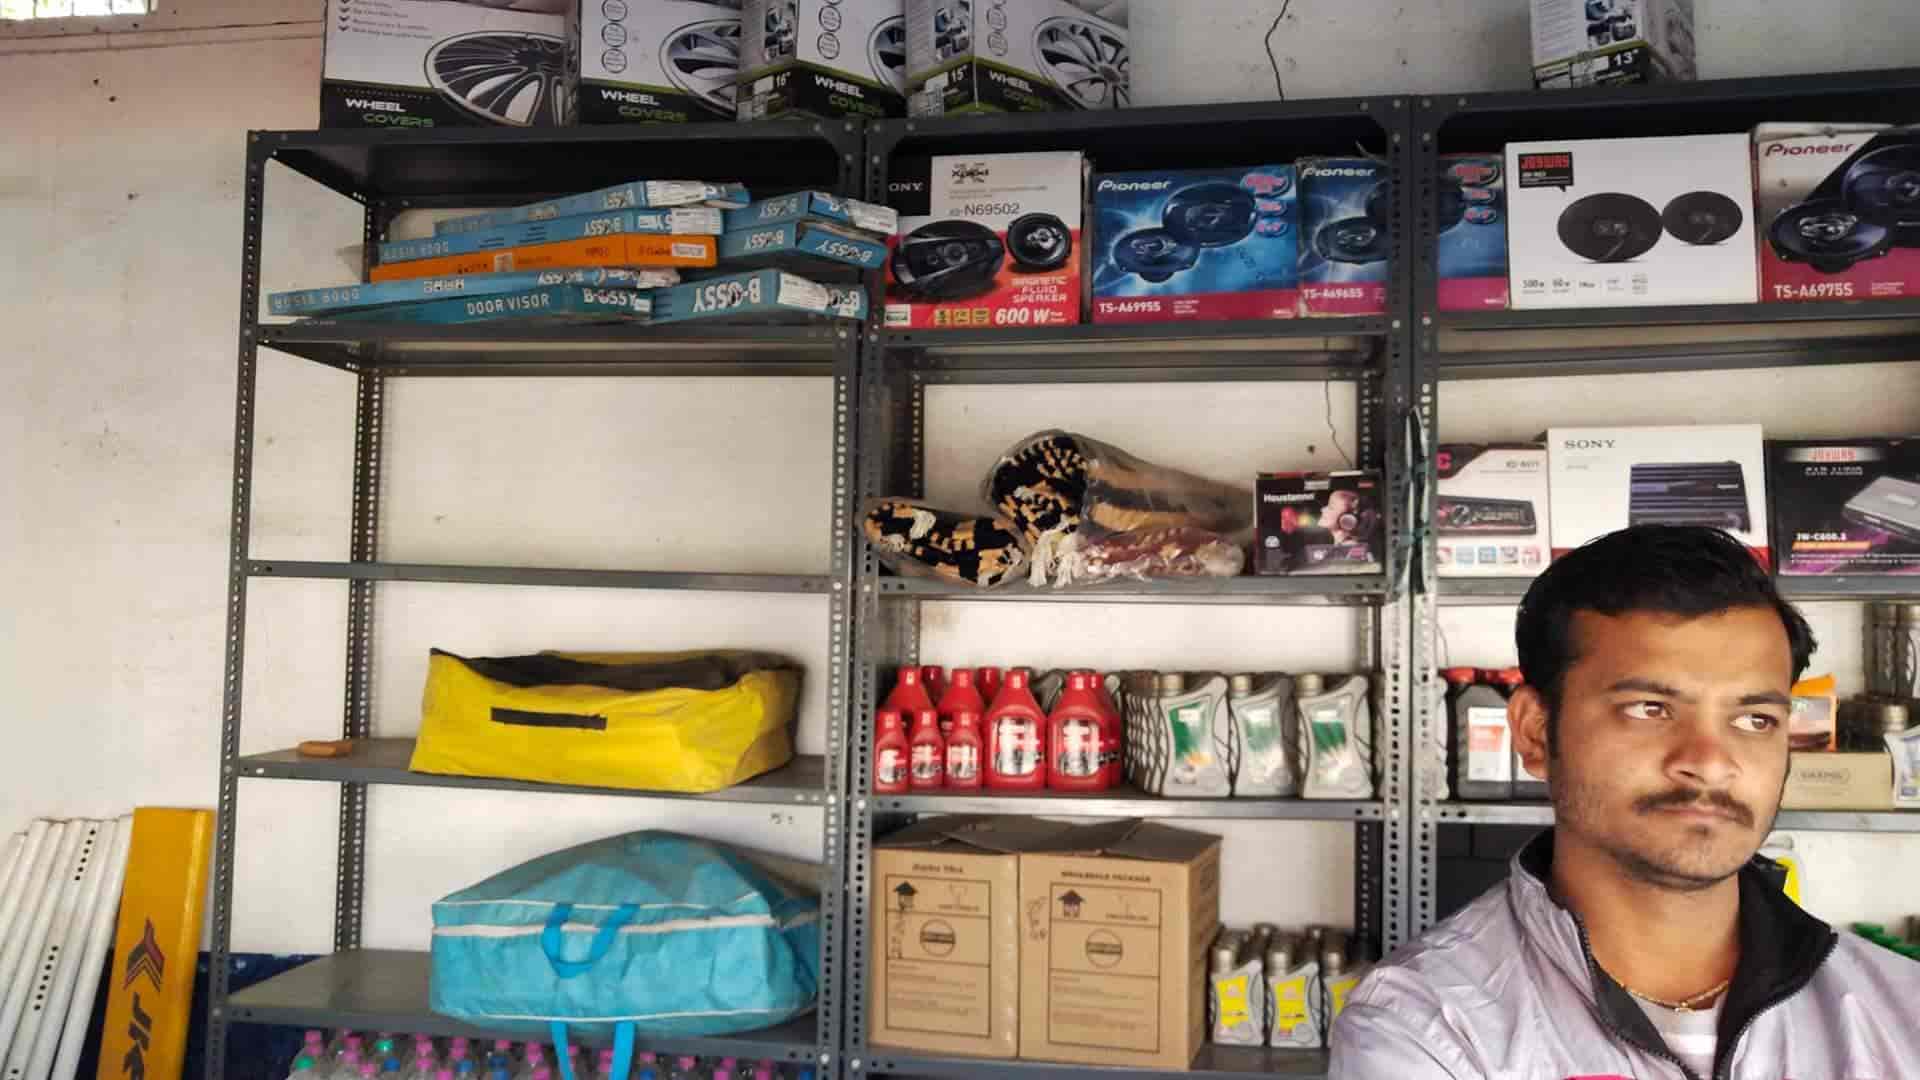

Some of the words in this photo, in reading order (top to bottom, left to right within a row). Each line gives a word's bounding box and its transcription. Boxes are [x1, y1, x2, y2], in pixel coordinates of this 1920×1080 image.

[814, 75, 865, 97] WHEEL
[989, 70, 1032, 93] WHEEL
[345, 98, 406, 112] WHEEL
[601, 90, 660, 107] WHEEL
[363, 113, 434, 128] COVERS
[618, 105, 688, 122] COVERS
[1765, 143, 1857, 157] Pioneer
[1301, 168, 1375, 179] Pioneer
[888, 182, 923, 192] ONY
[1097, 179, 1172, 192] Pioneer
[1022, 284, 1057, 294] FLUID
[1773, 282, 1854, 299] TS-A6975S
[467, 296, 504, 315] DOOR
[508, 294, 550, 312] VISOR
[1013, 293, 1068, 303] SPEAKER
[996, 306, 1029, 325] 600
[1033, 308, 1051, 324] W
[1563, 439, 1617, 449] SONY
